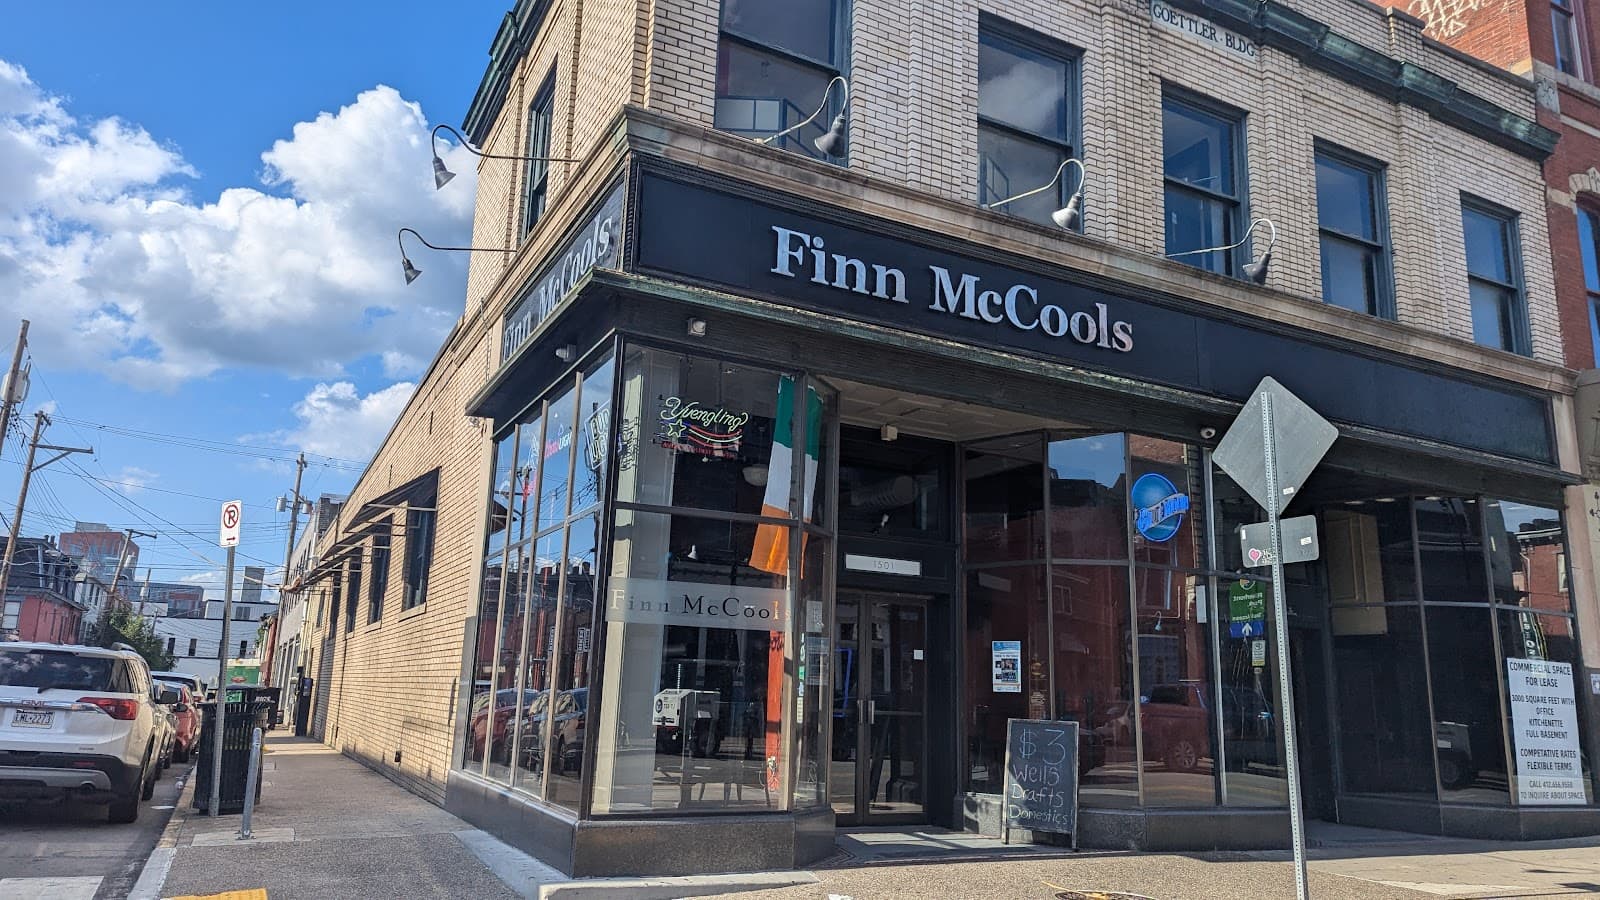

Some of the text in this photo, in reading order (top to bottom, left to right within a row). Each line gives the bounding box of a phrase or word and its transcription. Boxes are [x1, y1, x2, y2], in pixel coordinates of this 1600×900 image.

[1153, 4, 1256, 56] GOETTLER BLDG
[538, 215, 612, 322] McCools
[771, 225, 1134, 353] Finn McCools
[660, 396, 749, 434] Yuengling
[873, 560, 894, 570] 1501
[609, 588, 670, 613] Finn
[1509, 661, 1572, 676] COMMERCIAL SPACE
[1525, 676, 1559, 688] FOR LEASE
[1525, 695, 1547, 704] SQUARE
[1548, 696, 1560, 705] FEET
[1561, 698, 1575, 706] WITH
[1535, 706, 1555, 716] OFFICE
[1528, 718, 1564, 728] KITCHENETTE
[1525, 730, 1568, 739] FULL BASEMENT
[1560, 750, 1577, 759] RATES
[1527, 761, 1573, 771] FLEXIBLE TERMS
[1012, 764, 1060, 787] Wells
[1529, 780, 1541, 788] CALL
[1010, 783, 1065, 808] Drafts
[1520, 791, 1585, 800] TO INQUIRE ABOUT SPACE
